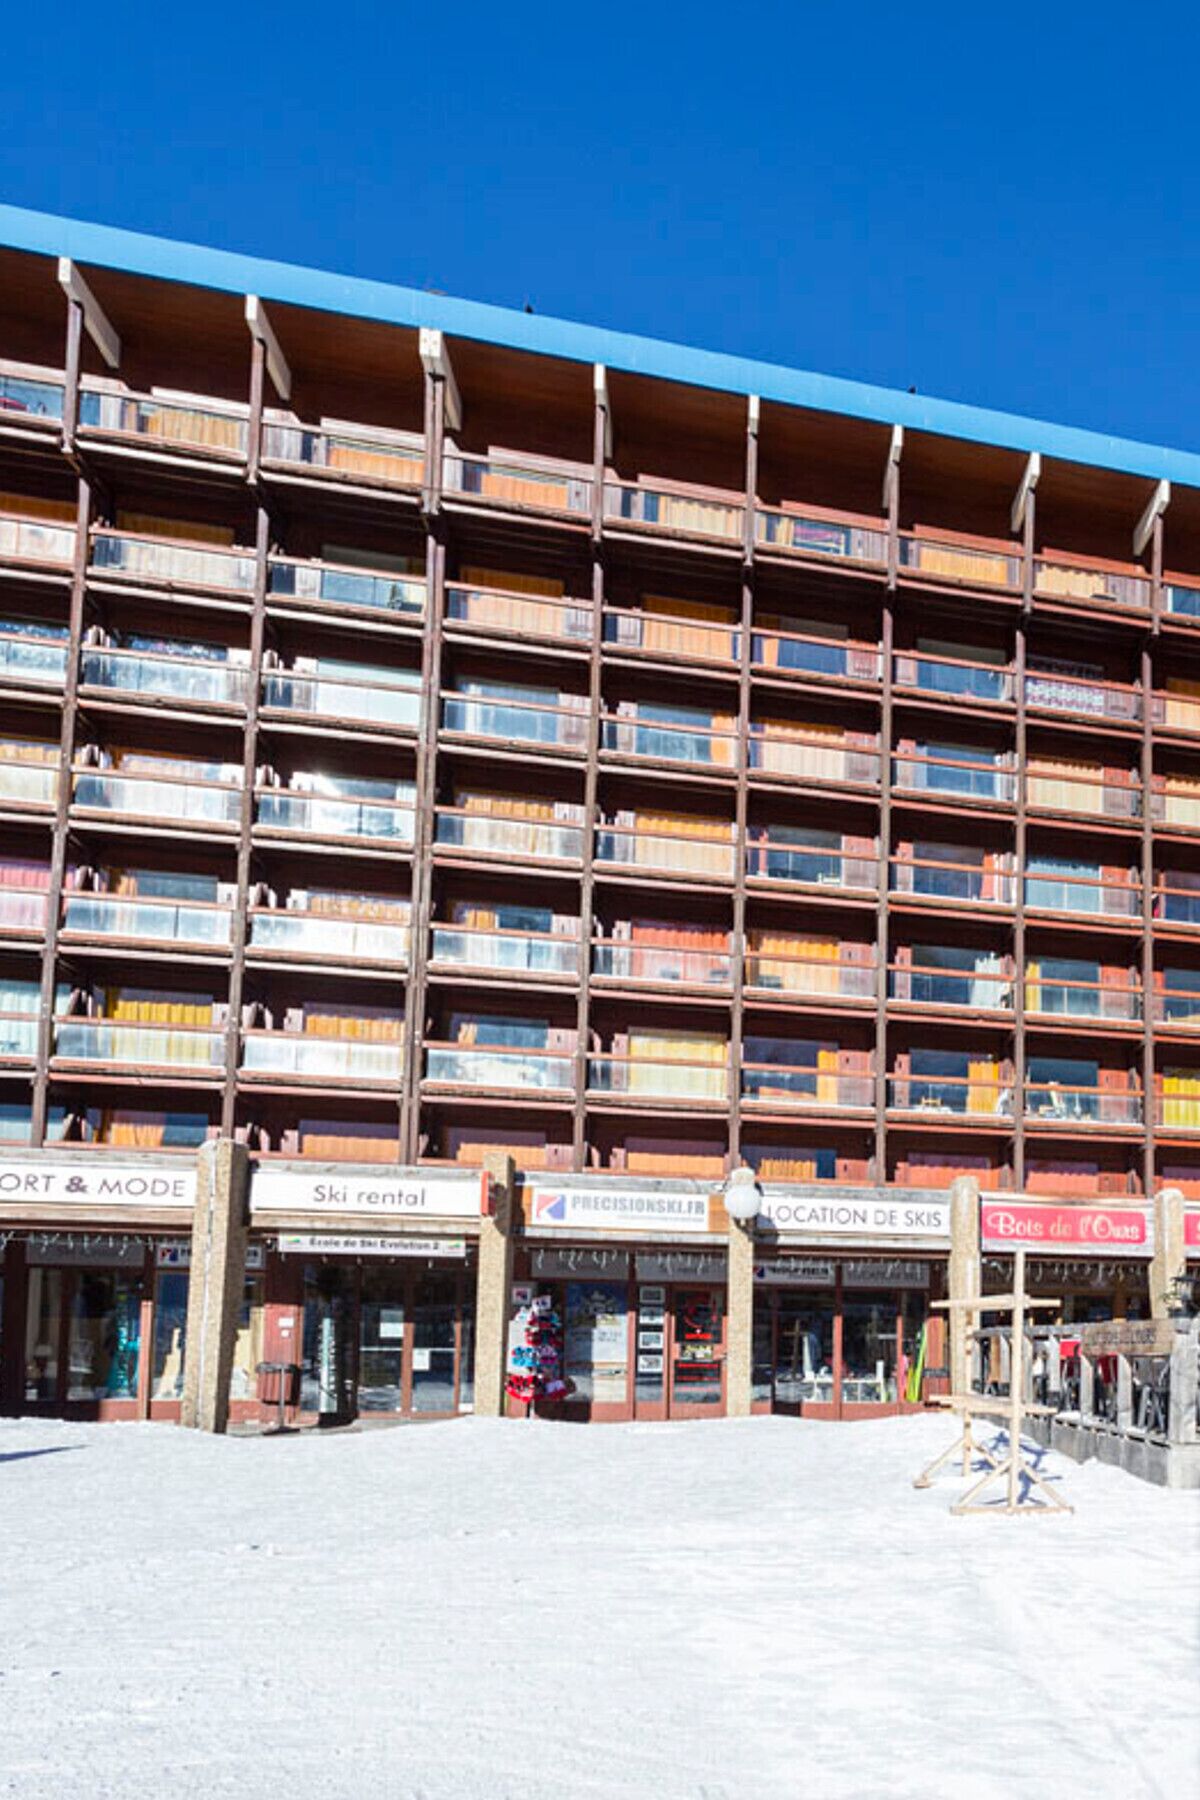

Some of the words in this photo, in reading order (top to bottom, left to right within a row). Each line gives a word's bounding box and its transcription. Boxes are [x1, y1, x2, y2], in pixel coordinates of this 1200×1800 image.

[65, 1175, 88, 1194] &
[98, 1178, 186, 1197] MODE
[313, 1184, 347, 1203] Ski
[356, 1187, 426, 1206] rental
[767, 1204, 868, 1225] LOCATION
[874, 1209, 898, 1226] DE
[904, 1210, 942, 1228] SKIS
[986, 1211, 1045, 1236] Bois
[1049, 1215, 1073, 1238] de
